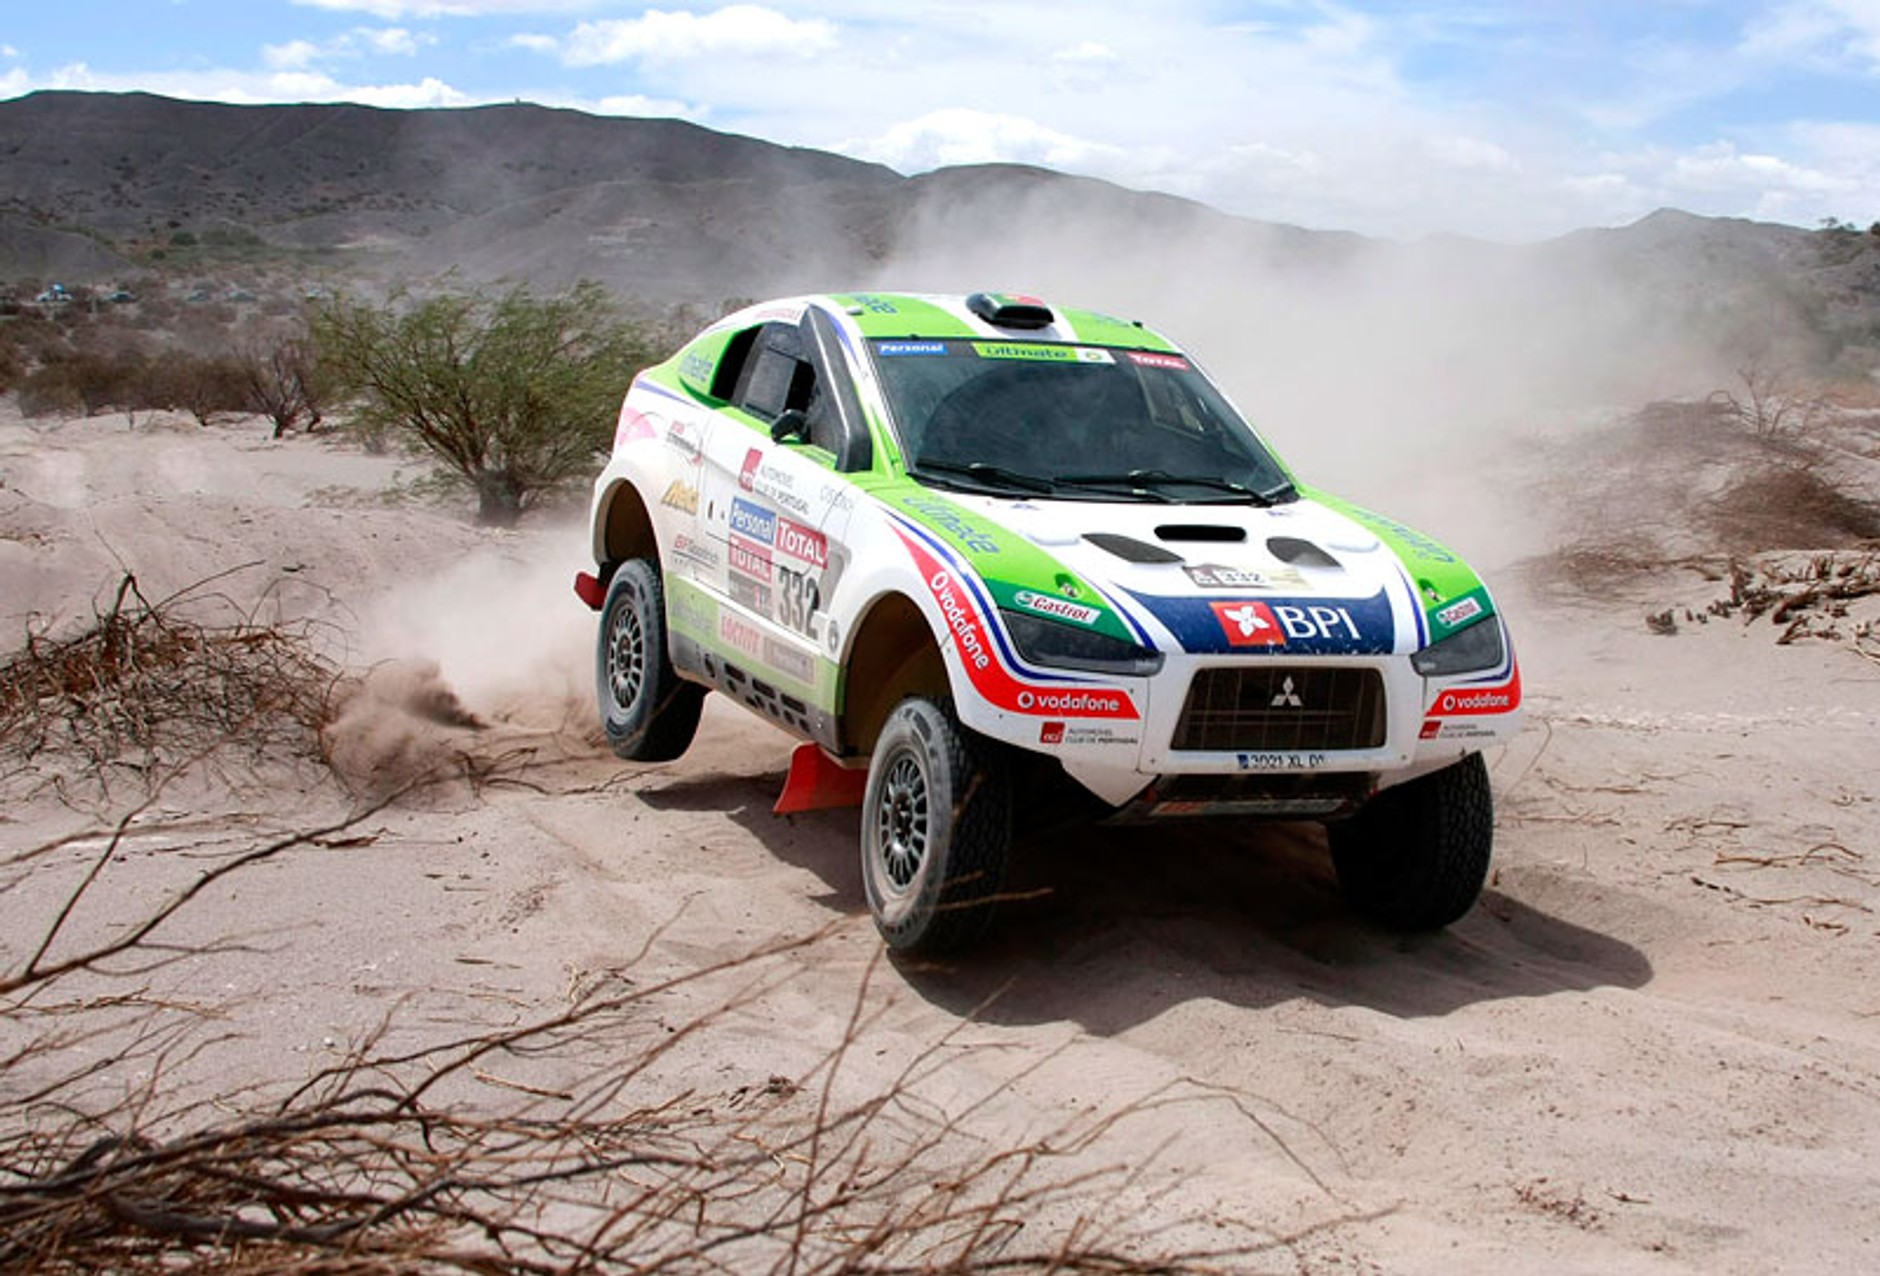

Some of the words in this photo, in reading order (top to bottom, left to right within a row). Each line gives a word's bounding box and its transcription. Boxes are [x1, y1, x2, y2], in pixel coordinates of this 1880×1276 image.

[881, 343, 944, 353] Personal
[1132, 354, 1187, 369] TOTAL
[732, 502, 774, 544] Personal
[778, 521, 824, 563] TOTAL
[729, 539, 772, 579] TOTAL
[1221, 572, 1266, 582] 332
[778, 565, 820, 641] 332
[1032, 596, 1089, 621] Castrol
[943, 589, 990, 670] vodafone
[1273, 606, 1361, 640] BPI
[1037, 691, 1119, 711] vodafone
[1457, 692, 1510, 708] vodafone
[1287, 754, 1303, 769] XL
